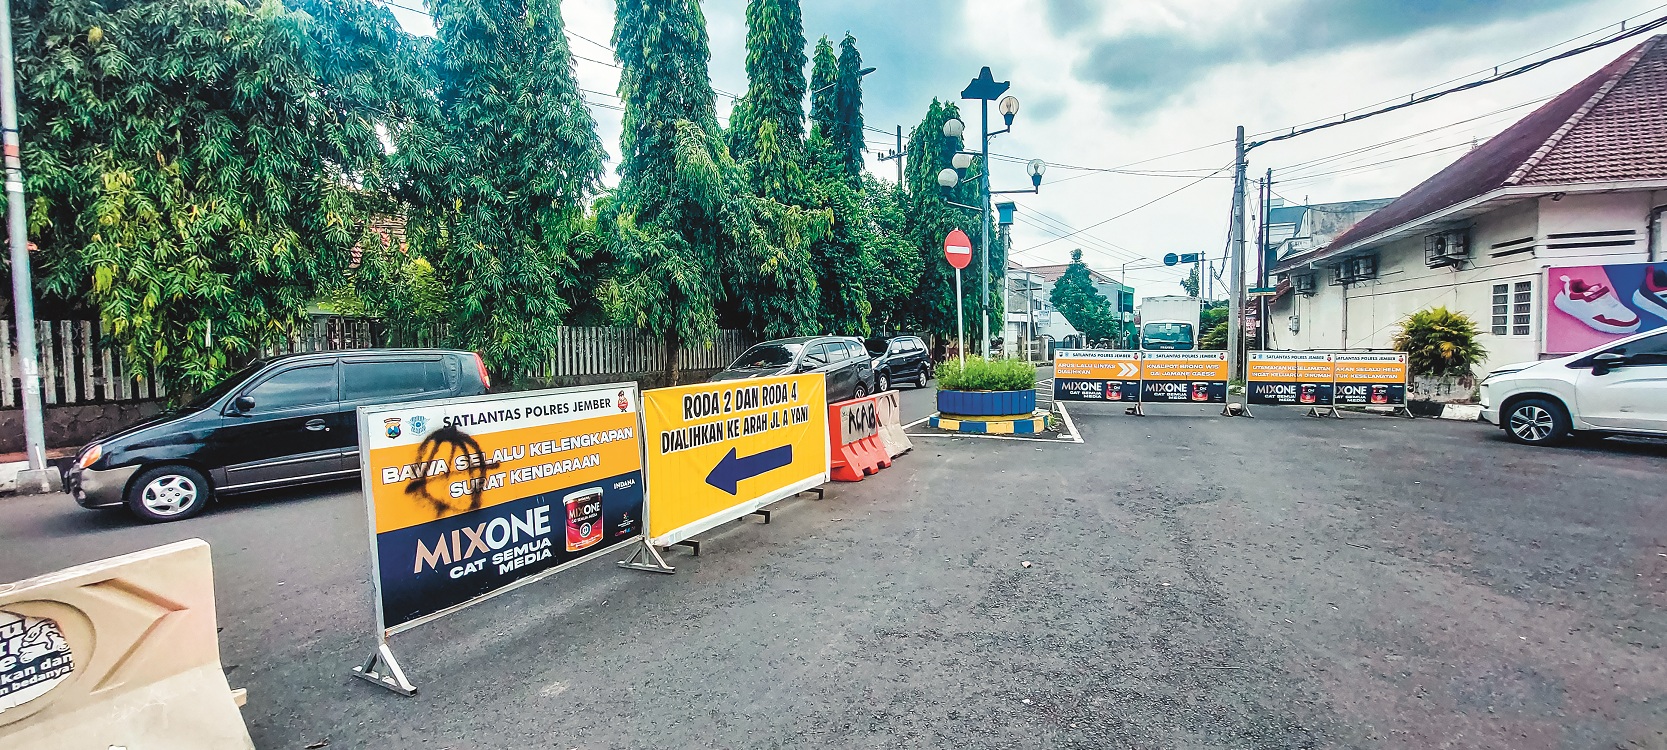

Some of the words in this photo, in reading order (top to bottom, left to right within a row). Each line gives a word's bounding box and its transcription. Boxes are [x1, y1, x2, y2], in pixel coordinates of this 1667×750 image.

[684, 392, 720, 420] RODA
[723, 391, 731, 413] 2
[735, 387, 759, 410] DAN
[762, 383, 788, 406] RODA
[791, 382, 797, 401] 4
[1062, 382, 1102, 391] MIXONE
[1145, 383, 1187, 392] MIXONE
[1256, 385, 1296, 394] MIXONE
[443, 408, 521, 429] SATLANTAS
[525, 402, 570, 419] POLRES
[572, 397, 611, 413] JEMBER
[848, 402, 876, 435] ACAB
[661, 422, 723, 454] DIALIHKAN
[727, 419, 740, 439] KE
[743, 413, 768, 436] ARAH
[770, 411, 780, 429] JL
[782, 409, 788, 426] A
[791, 405, 809, 424] YANI
[382, 458, 450, 485] BAWA
[454, 446, 525, 472] SELALU
[530, 427, 634, 457] KELENGKAPAN
[449, 471, 507, 499] SURAT
[509, 453, 601, 484] KENDARAAN
[569, 502, 600, 520] MIXONE
[413, 505, 551, 574] MIXONE
[449, 557, 486, 580] CAT
[491, 537, 552, 565] SEMUA
[499, 548, 553, 576] MEDIA
[12, 662, 75, 691] bedanya!
[40, 654, 73, 670] dan
